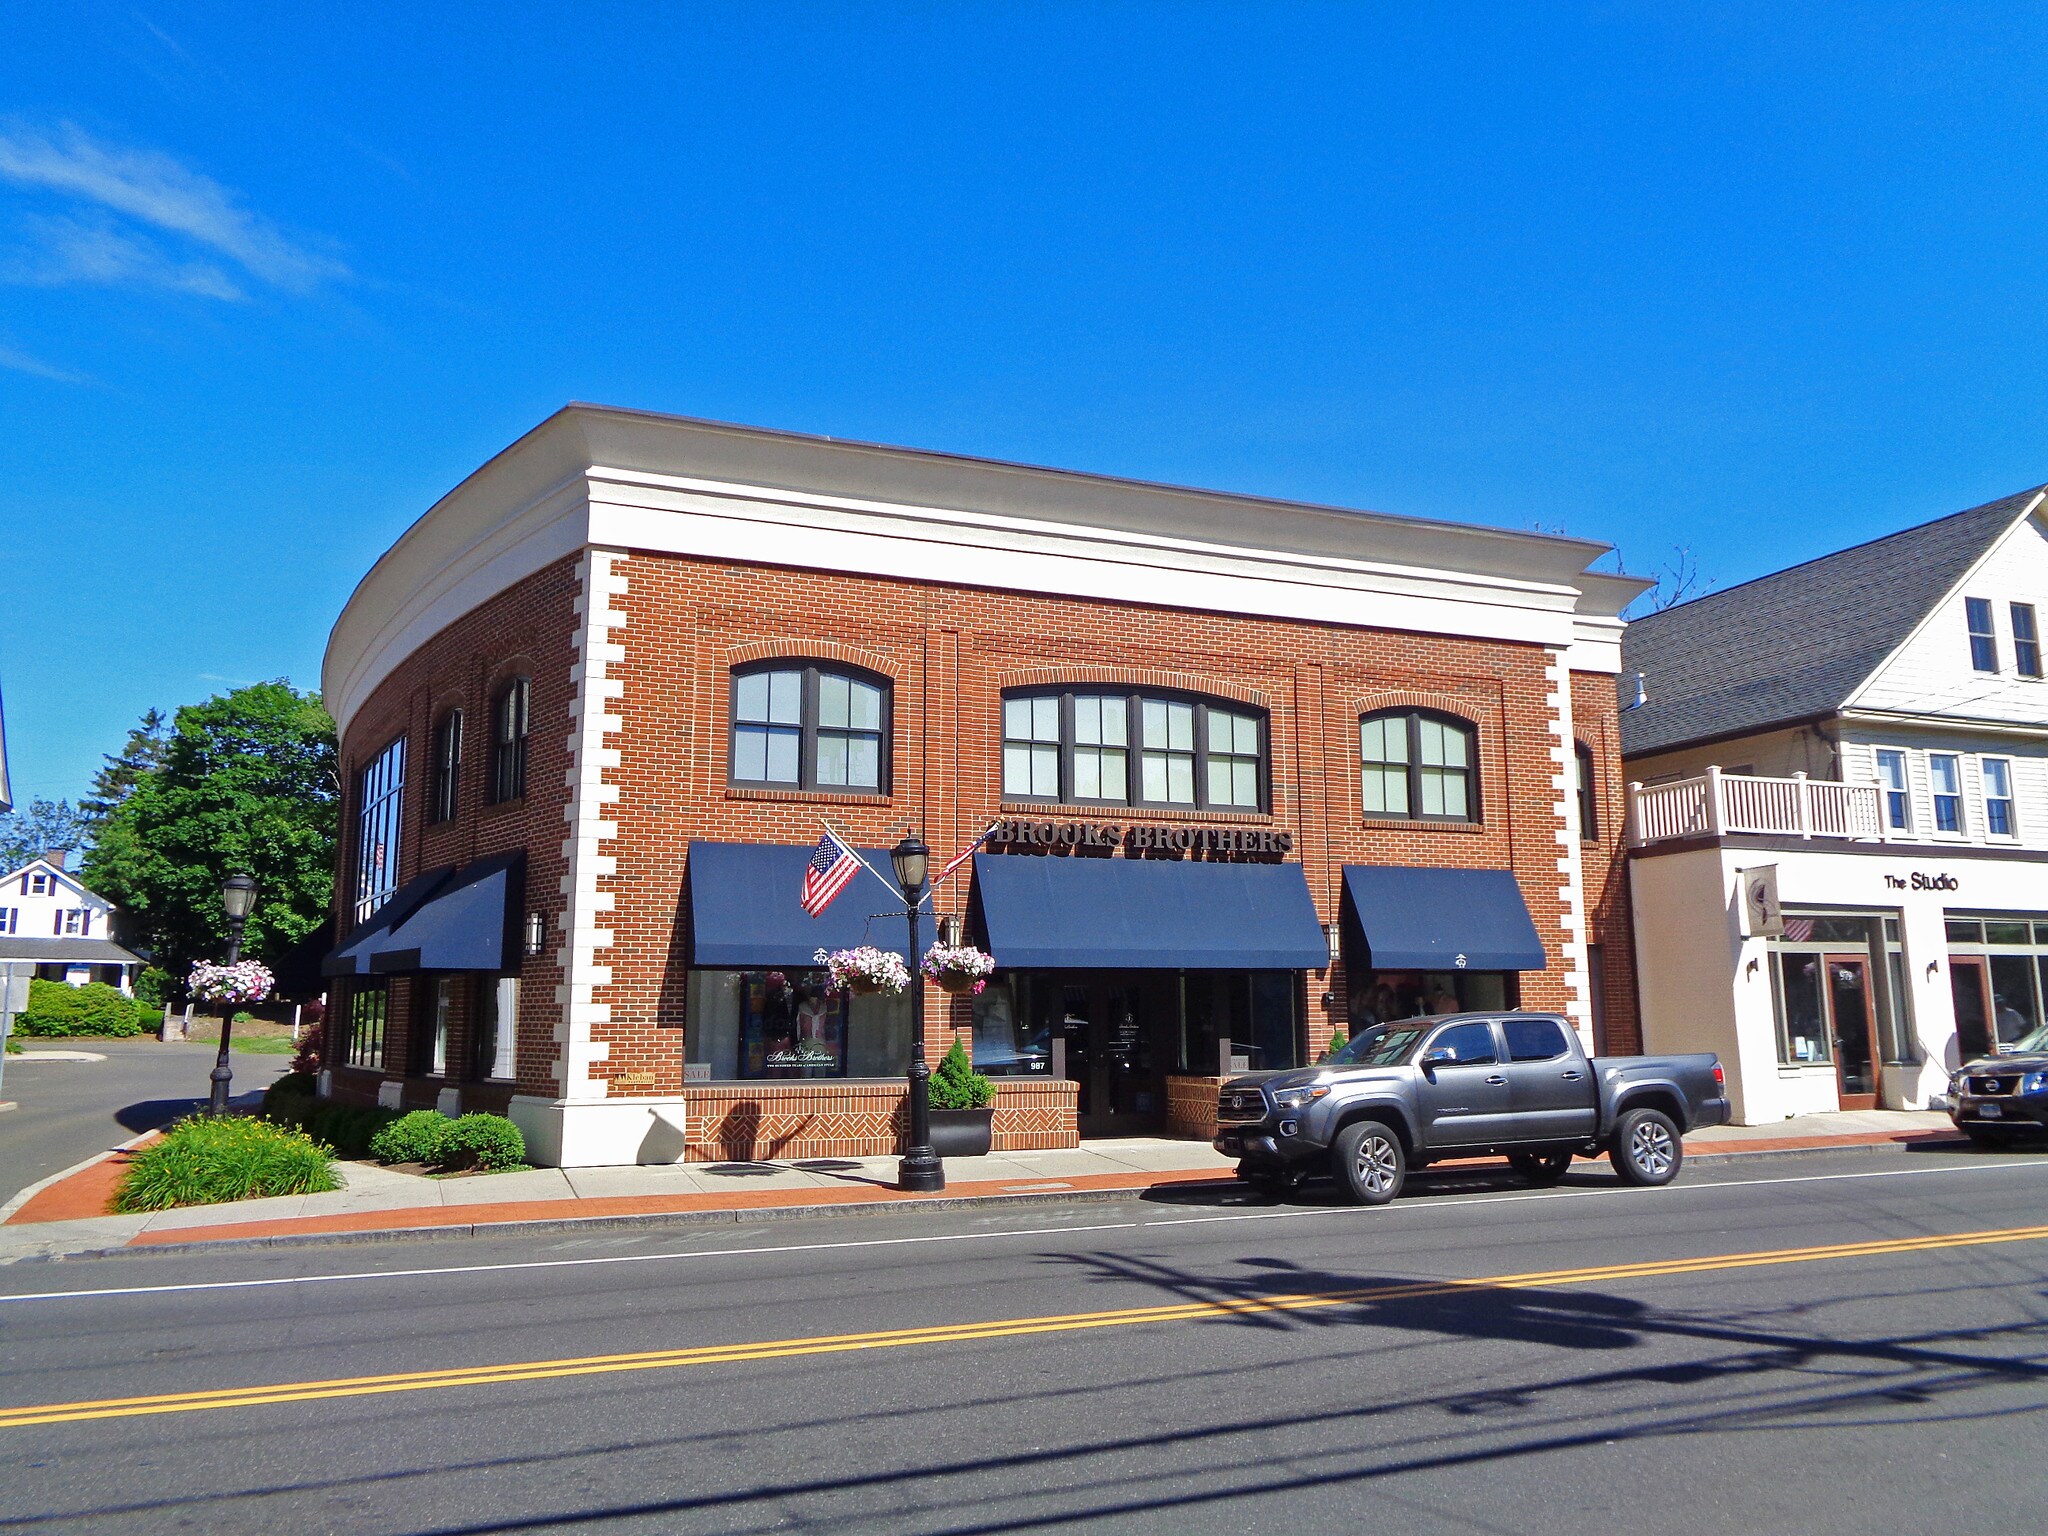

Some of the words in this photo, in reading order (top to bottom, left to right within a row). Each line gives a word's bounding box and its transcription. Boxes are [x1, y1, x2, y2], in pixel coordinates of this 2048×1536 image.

[995, 820, 1121, 848] BROOKS
[1134, 826, 1294, 852] BROTHERS
[1884, 874, 1907, 890] The
[1911, 871, 1959, 891] Studio
[1030, 1062, 1046, 1070] 987
[684, 1070, 709, 1079] SALE
